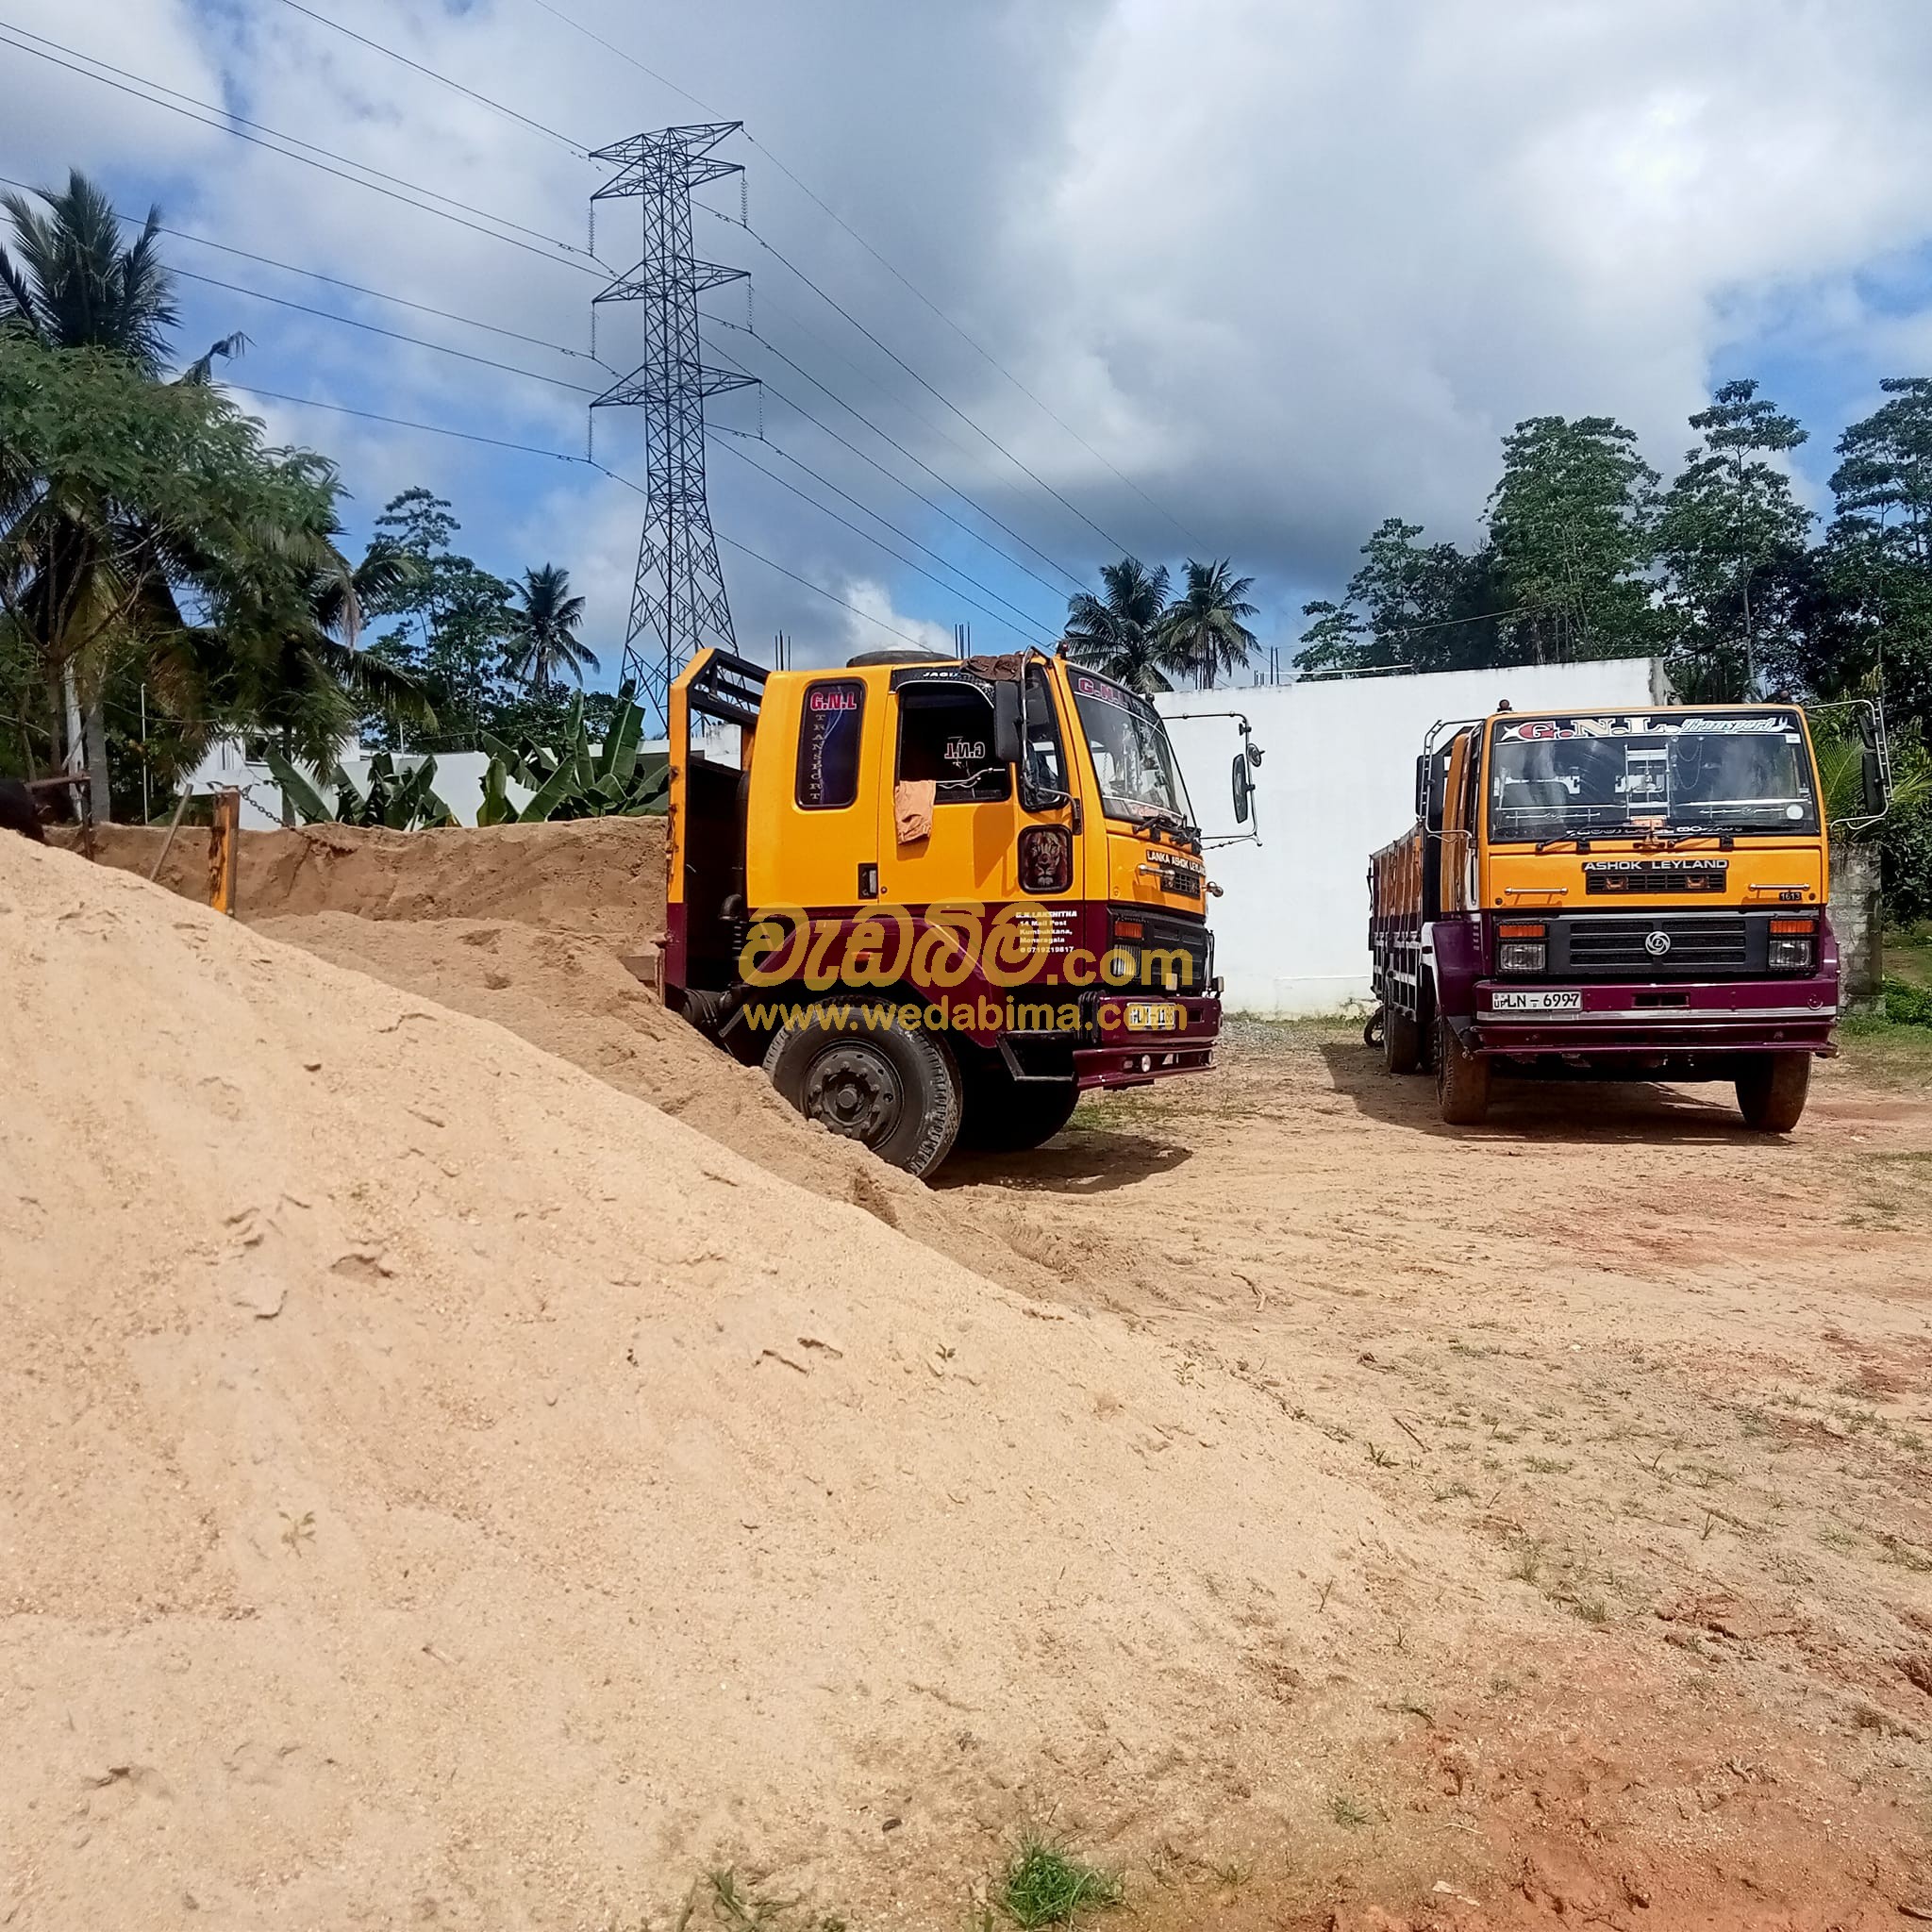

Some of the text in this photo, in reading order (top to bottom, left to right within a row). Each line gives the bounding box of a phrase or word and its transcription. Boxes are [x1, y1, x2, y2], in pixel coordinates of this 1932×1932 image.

[810, 691, 857, 711] G.N.L
[1681, 717, 1776, 734] Transport
[1147, 850, 1170, 864] LANKA
[1171, 856, 1190, 869] ASHOK
[1584, 859, 1729, 871] ASHOK LEYLAND
